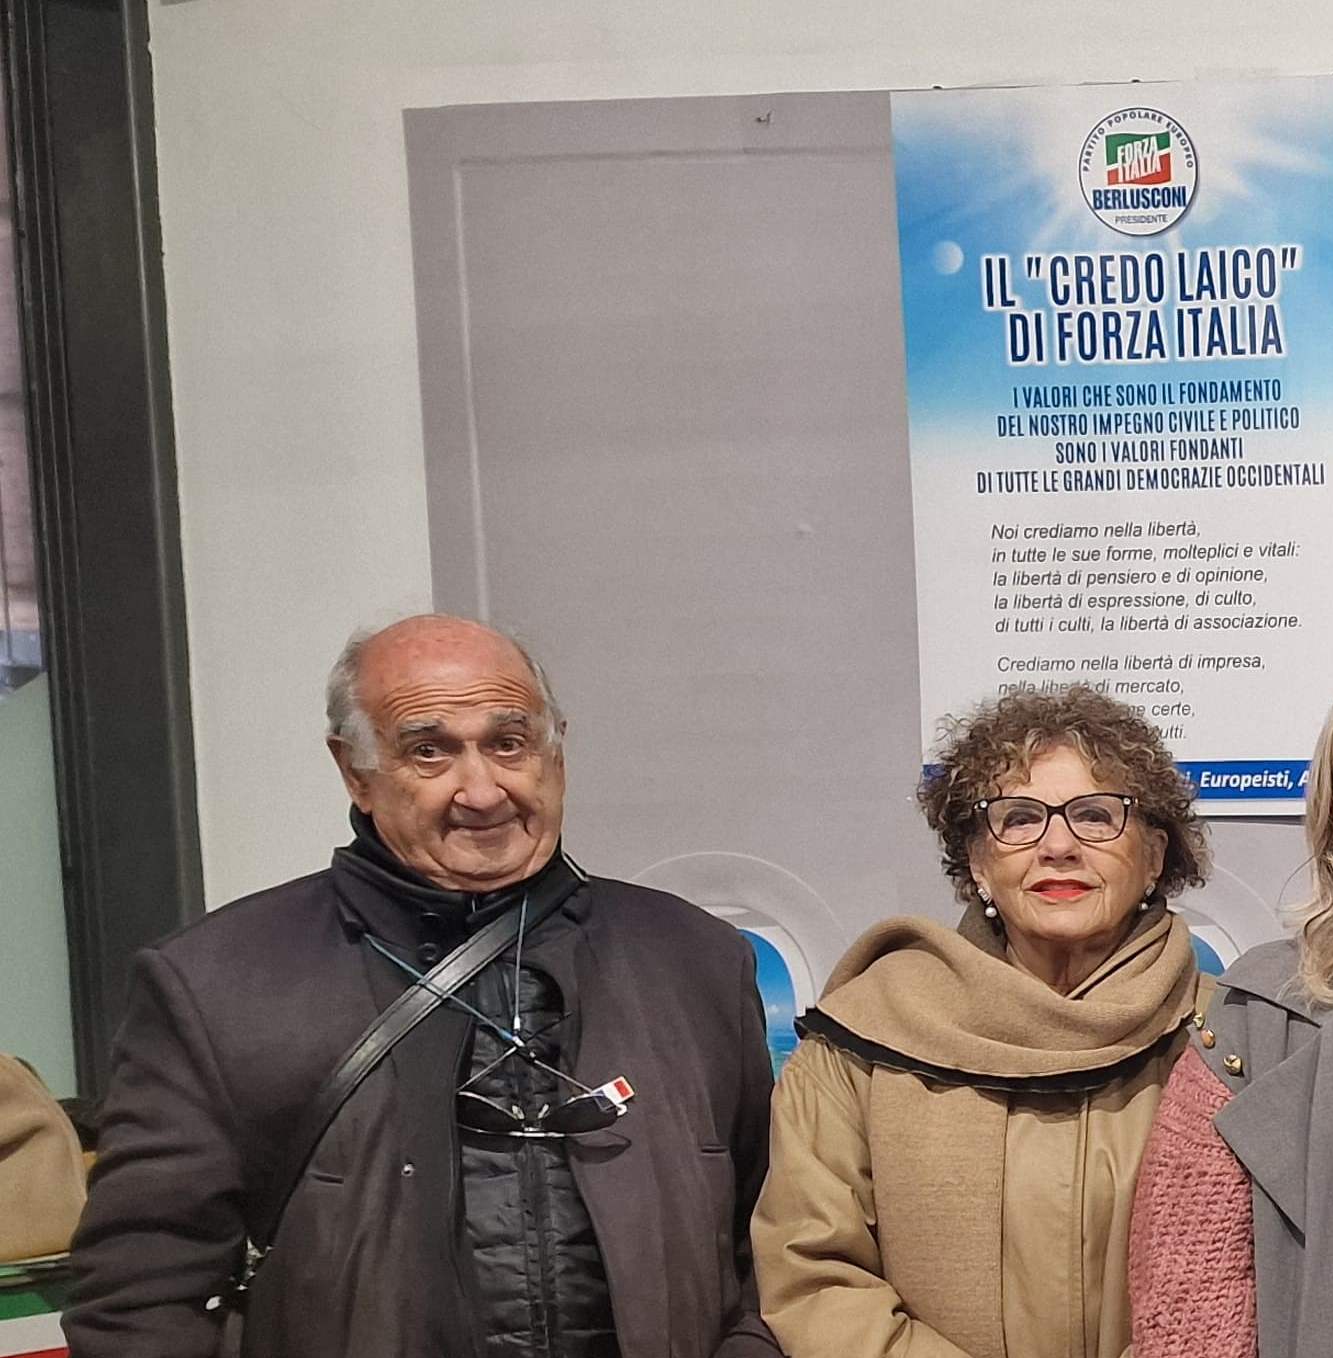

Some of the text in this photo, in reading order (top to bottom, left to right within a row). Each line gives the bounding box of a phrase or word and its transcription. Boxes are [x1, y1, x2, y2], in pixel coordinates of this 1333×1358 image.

[1082, 111, 1193, 172] PARTITO POPOLARE EUROPEO
[1117, 135, 1158, 165] FORZA
[1118, 153, 1162, 182] ITALIA
[1092, 186, 1187, 211] BERLUSCONI
[1115, 214, 1168, 224] PRESIDENTE
[984, 247, 1297, 307] IL "CREDO LAICO"
[1009, 305, 1283, 362] DI FORZA ITALIA
[1022, 379, 1281, 409] VALORI CHE SONO IL FONDAMENTO
[998, 407, 1300, 437] DEL NOSTRO IMPEGNO CIVILE E POLITICO
[1055, 437, 1243, 464] SONO VALORI FONDANTI
[977, 463, 1325, 494] DI TUTTE LE GRANDI DEMOCRAZIE OCCIDENTALI
[991, 520, 1200, 540] Noi crediamo nella libertà,
[992, 541, 1301, 563] in tutte le sue forme, molteplici vitali:
[993, 567, 1268, 587] la libertà di pensiero di opinione,
[994, 590, 1256, 611] la libertà di espressione, di culto,
[995, 612, 1302, 633] di tutti culti, la libertà di associazione.
[997, 654, 1265, 673] Crediamo nella libertà di impresa,
[999, 679, 1184, 694] nella di mercato,
[1152, 703, 1195, 717] certe,
[1200, 769, 1294, 791] Europeisti,
